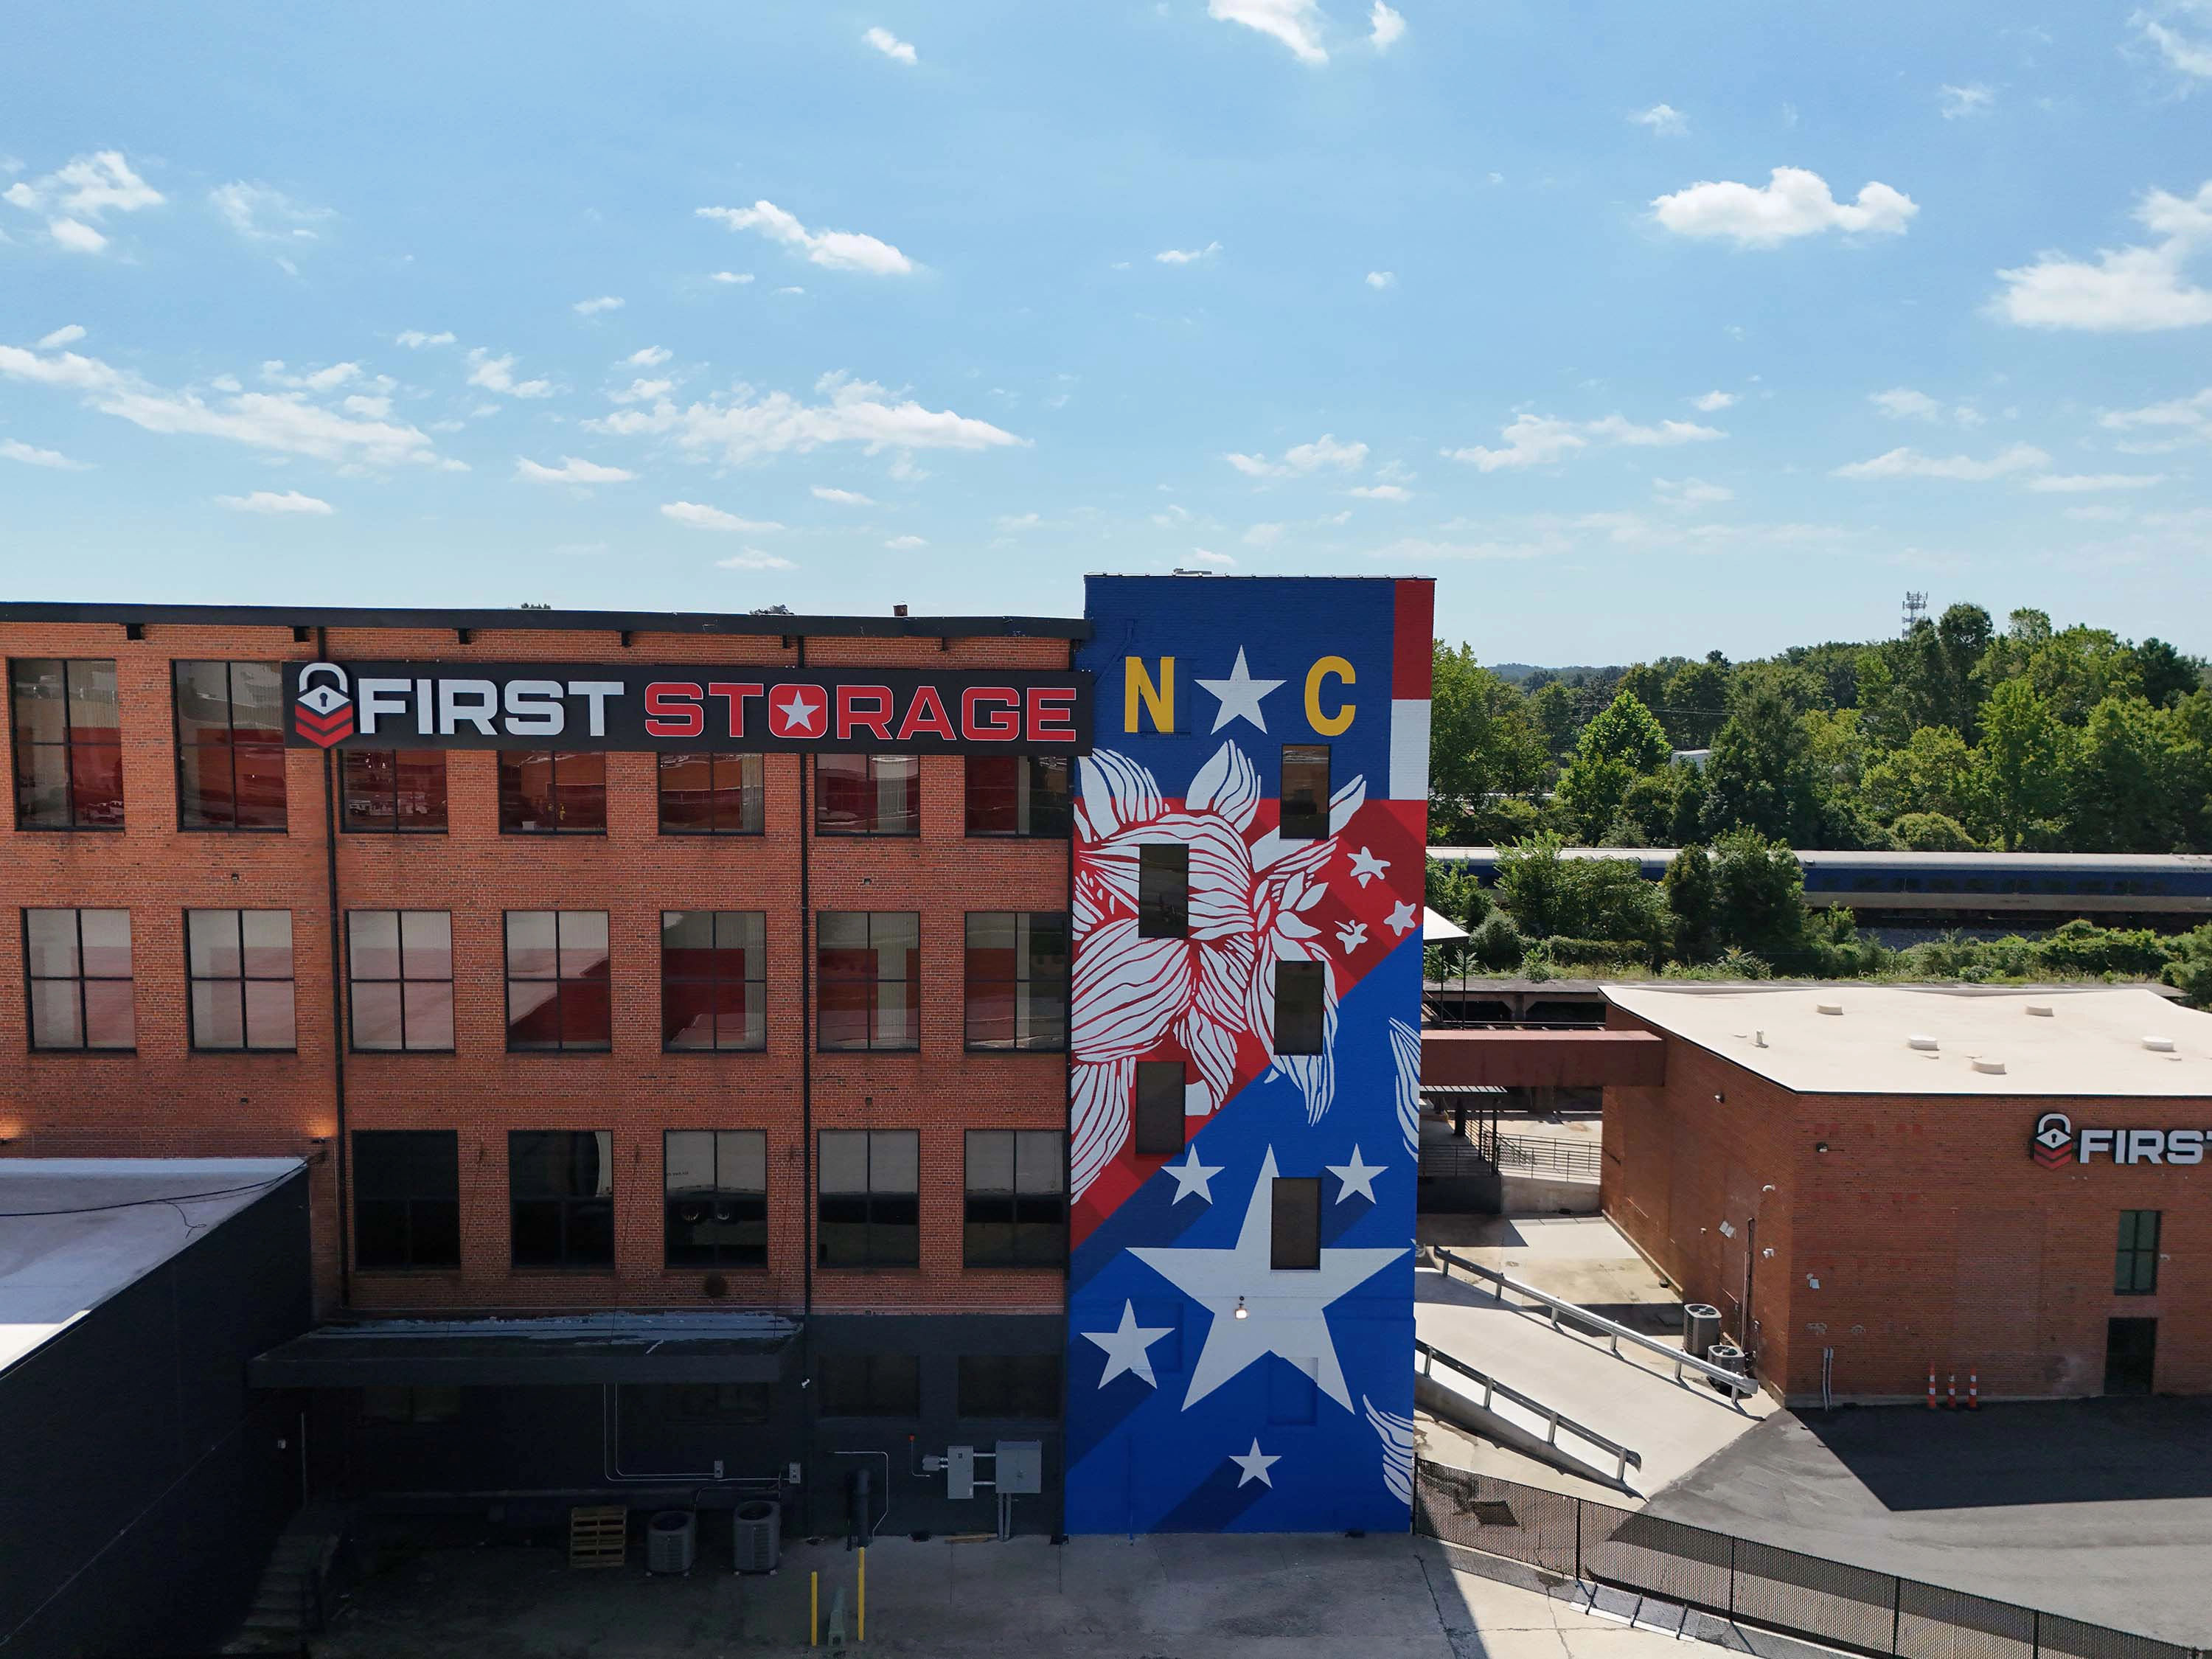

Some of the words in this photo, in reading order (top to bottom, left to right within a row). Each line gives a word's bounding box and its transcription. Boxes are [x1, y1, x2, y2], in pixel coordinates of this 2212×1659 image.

[358, 678, 625, 737] FIRST
[644, 681, 1077, 742] STORAGE
[1124, 656, 1175, 734] N
[1304, 655, 1357, 737] C
[2079, 1130, 2212, 1165] FIRS
